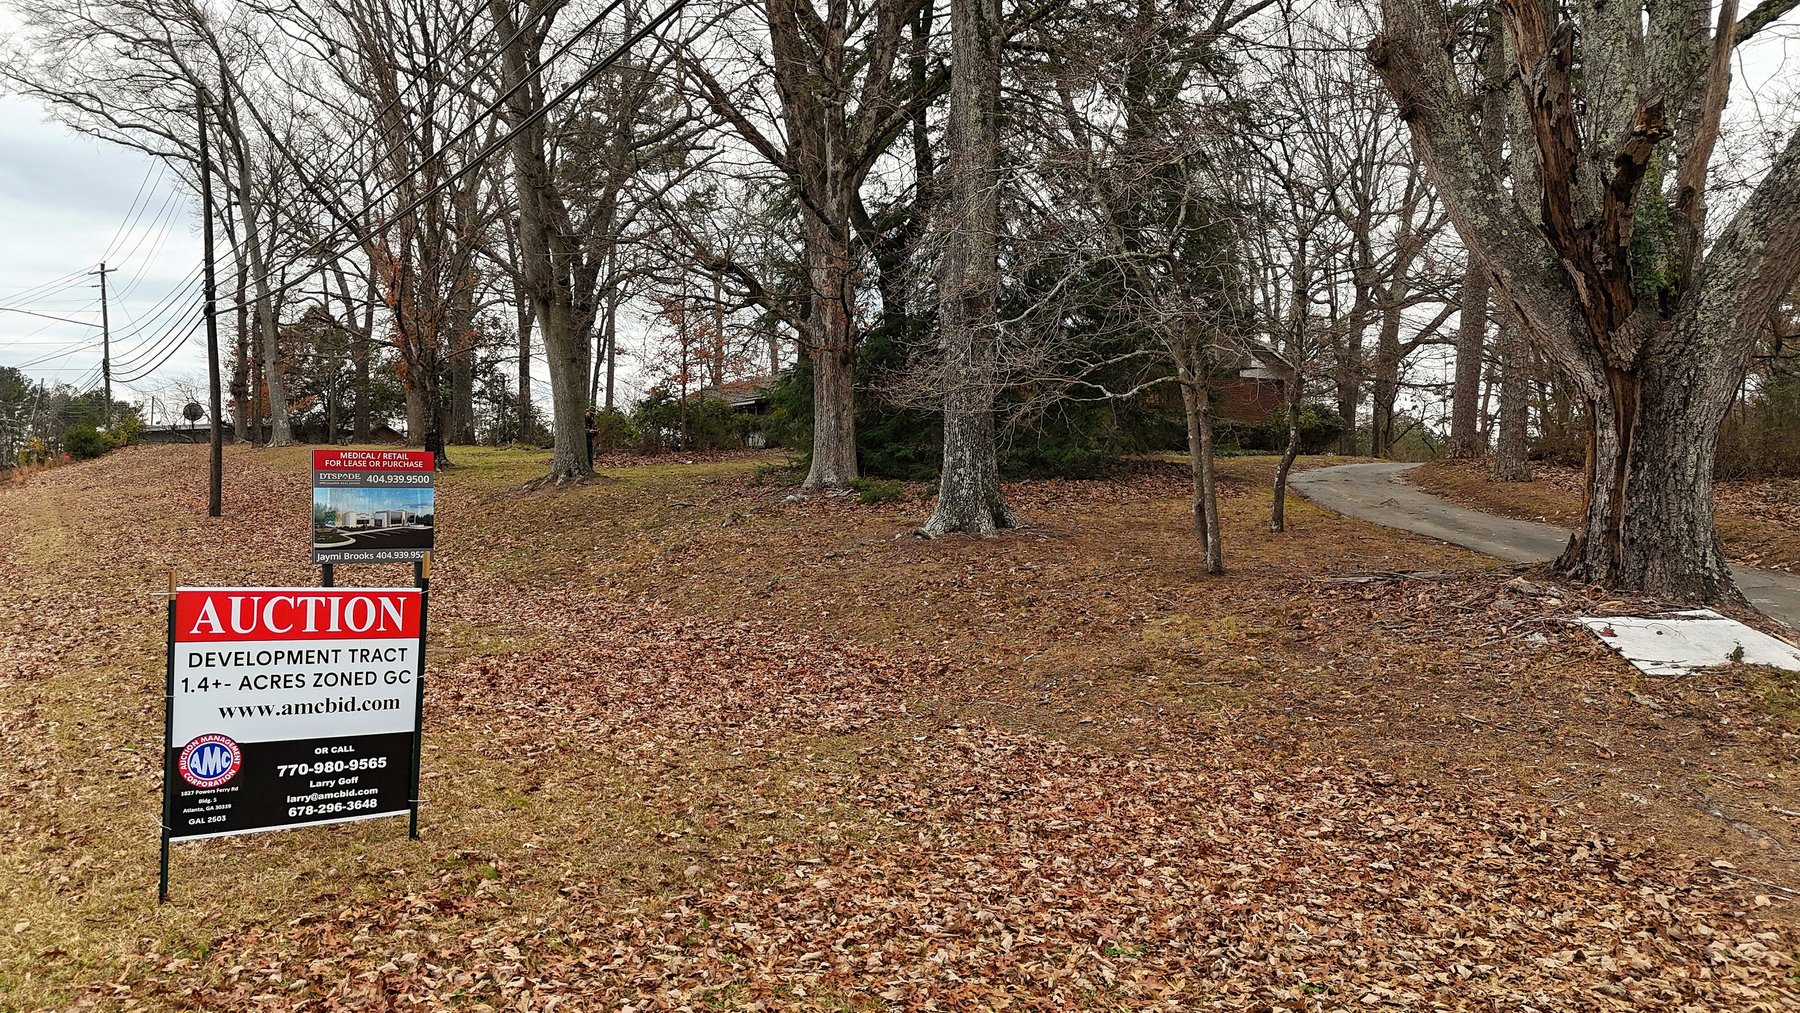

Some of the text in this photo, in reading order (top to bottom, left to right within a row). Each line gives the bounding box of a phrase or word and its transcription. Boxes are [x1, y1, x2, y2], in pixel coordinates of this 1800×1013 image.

[340, 452, 376, 460] MEDICAL
[366, 475, 430, 484] 404.939.9500
[316, 551, 424, 562] Jaymi Brooks 404.939.952
[189, 596, 408, 634] AUCTION
[189, 648, 408, 668] DEVELOPMENT TRACT
[181, 670, 412, 693] 1.4+- ACRES ZONED GC
[218, 697, 400, 719] www.amcbid.com
[180, 740, 199, 770] AUCTION
[200, 735, 240, 765] MANAGEMENT
[314, 745, 355, 755] OR CALL
[191, 746, 231, 776] AMC
[277, 757, 387, 777] 770-980-9565
[184, 769, 236, 788] CORPORATION
[309, 776, 359, 788] Larry Goff
[287, 788, 378, 803] larry@amcbid.com
[288, 799, 378, 817] 678-296-3648
[188, 815, 226, 825] GAL 2503
